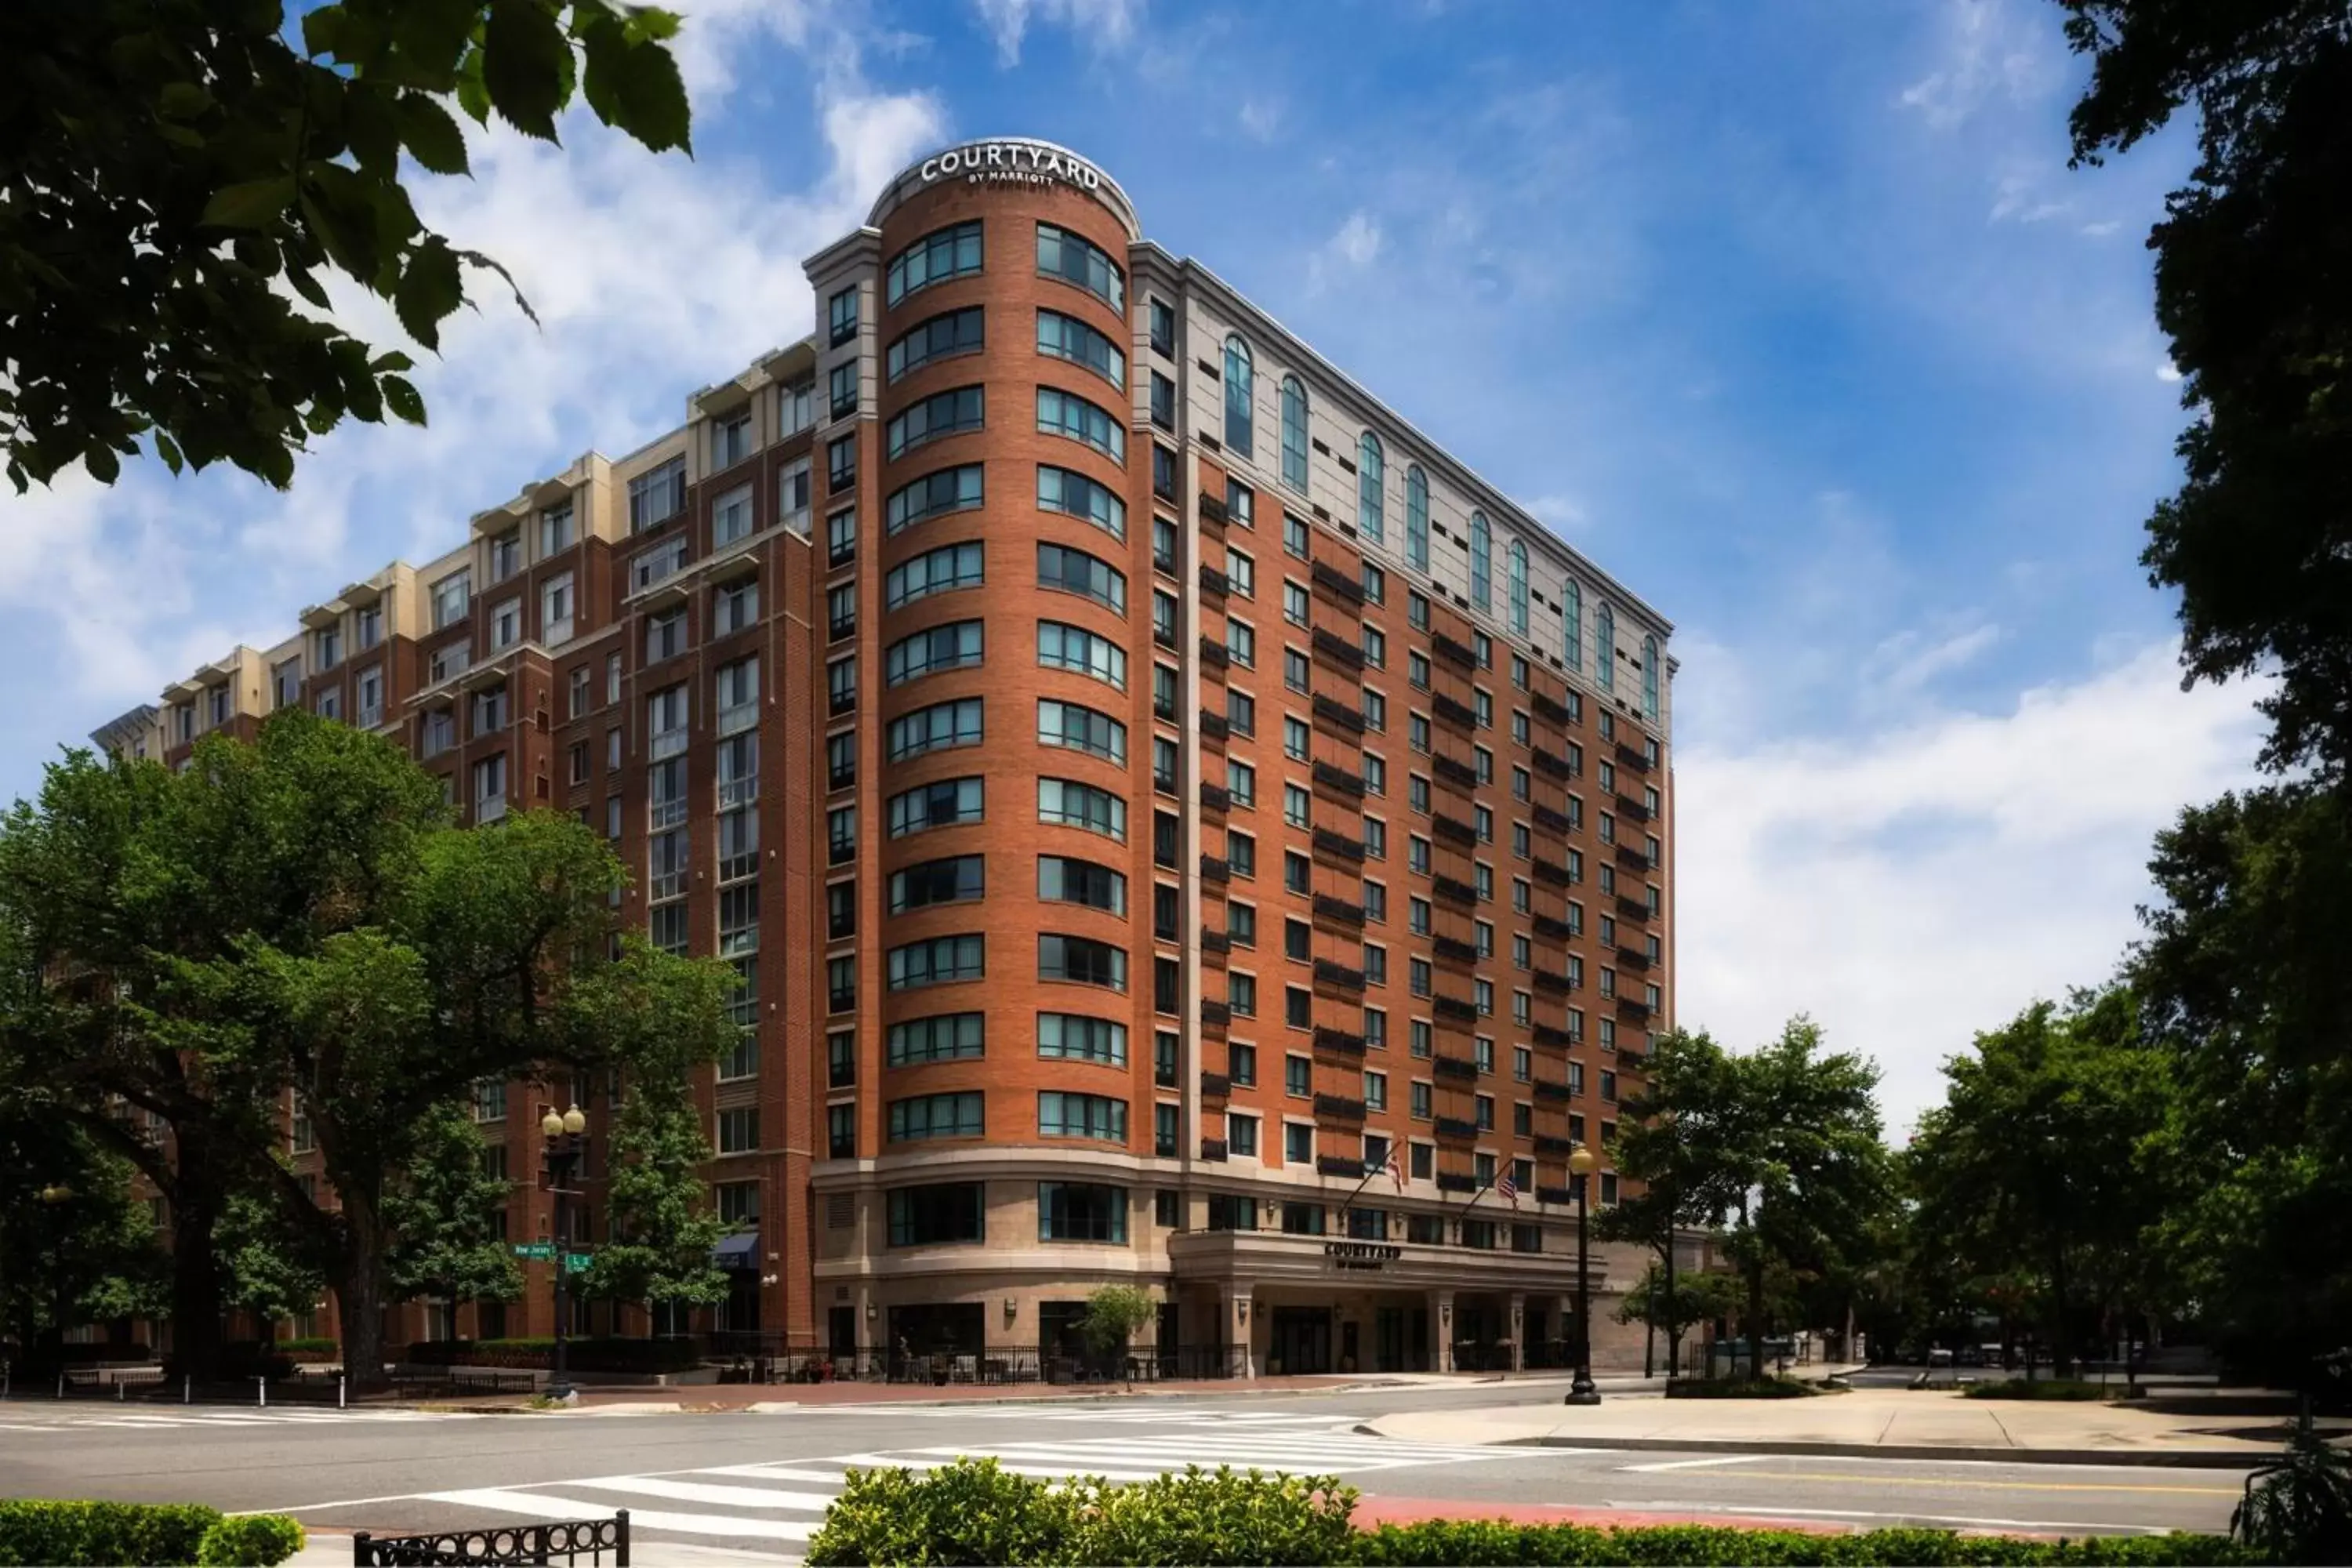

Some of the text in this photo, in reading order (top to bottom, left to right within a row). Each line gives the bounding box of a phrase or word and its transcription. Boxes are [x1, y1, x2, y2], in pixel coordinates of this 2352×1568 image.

[921, 144, 1098, 190] COURTYARD
[969, 171, 1054, 187] BY MARRIOTT
[1325, 1242, 1401, 1259] COURTYARD
